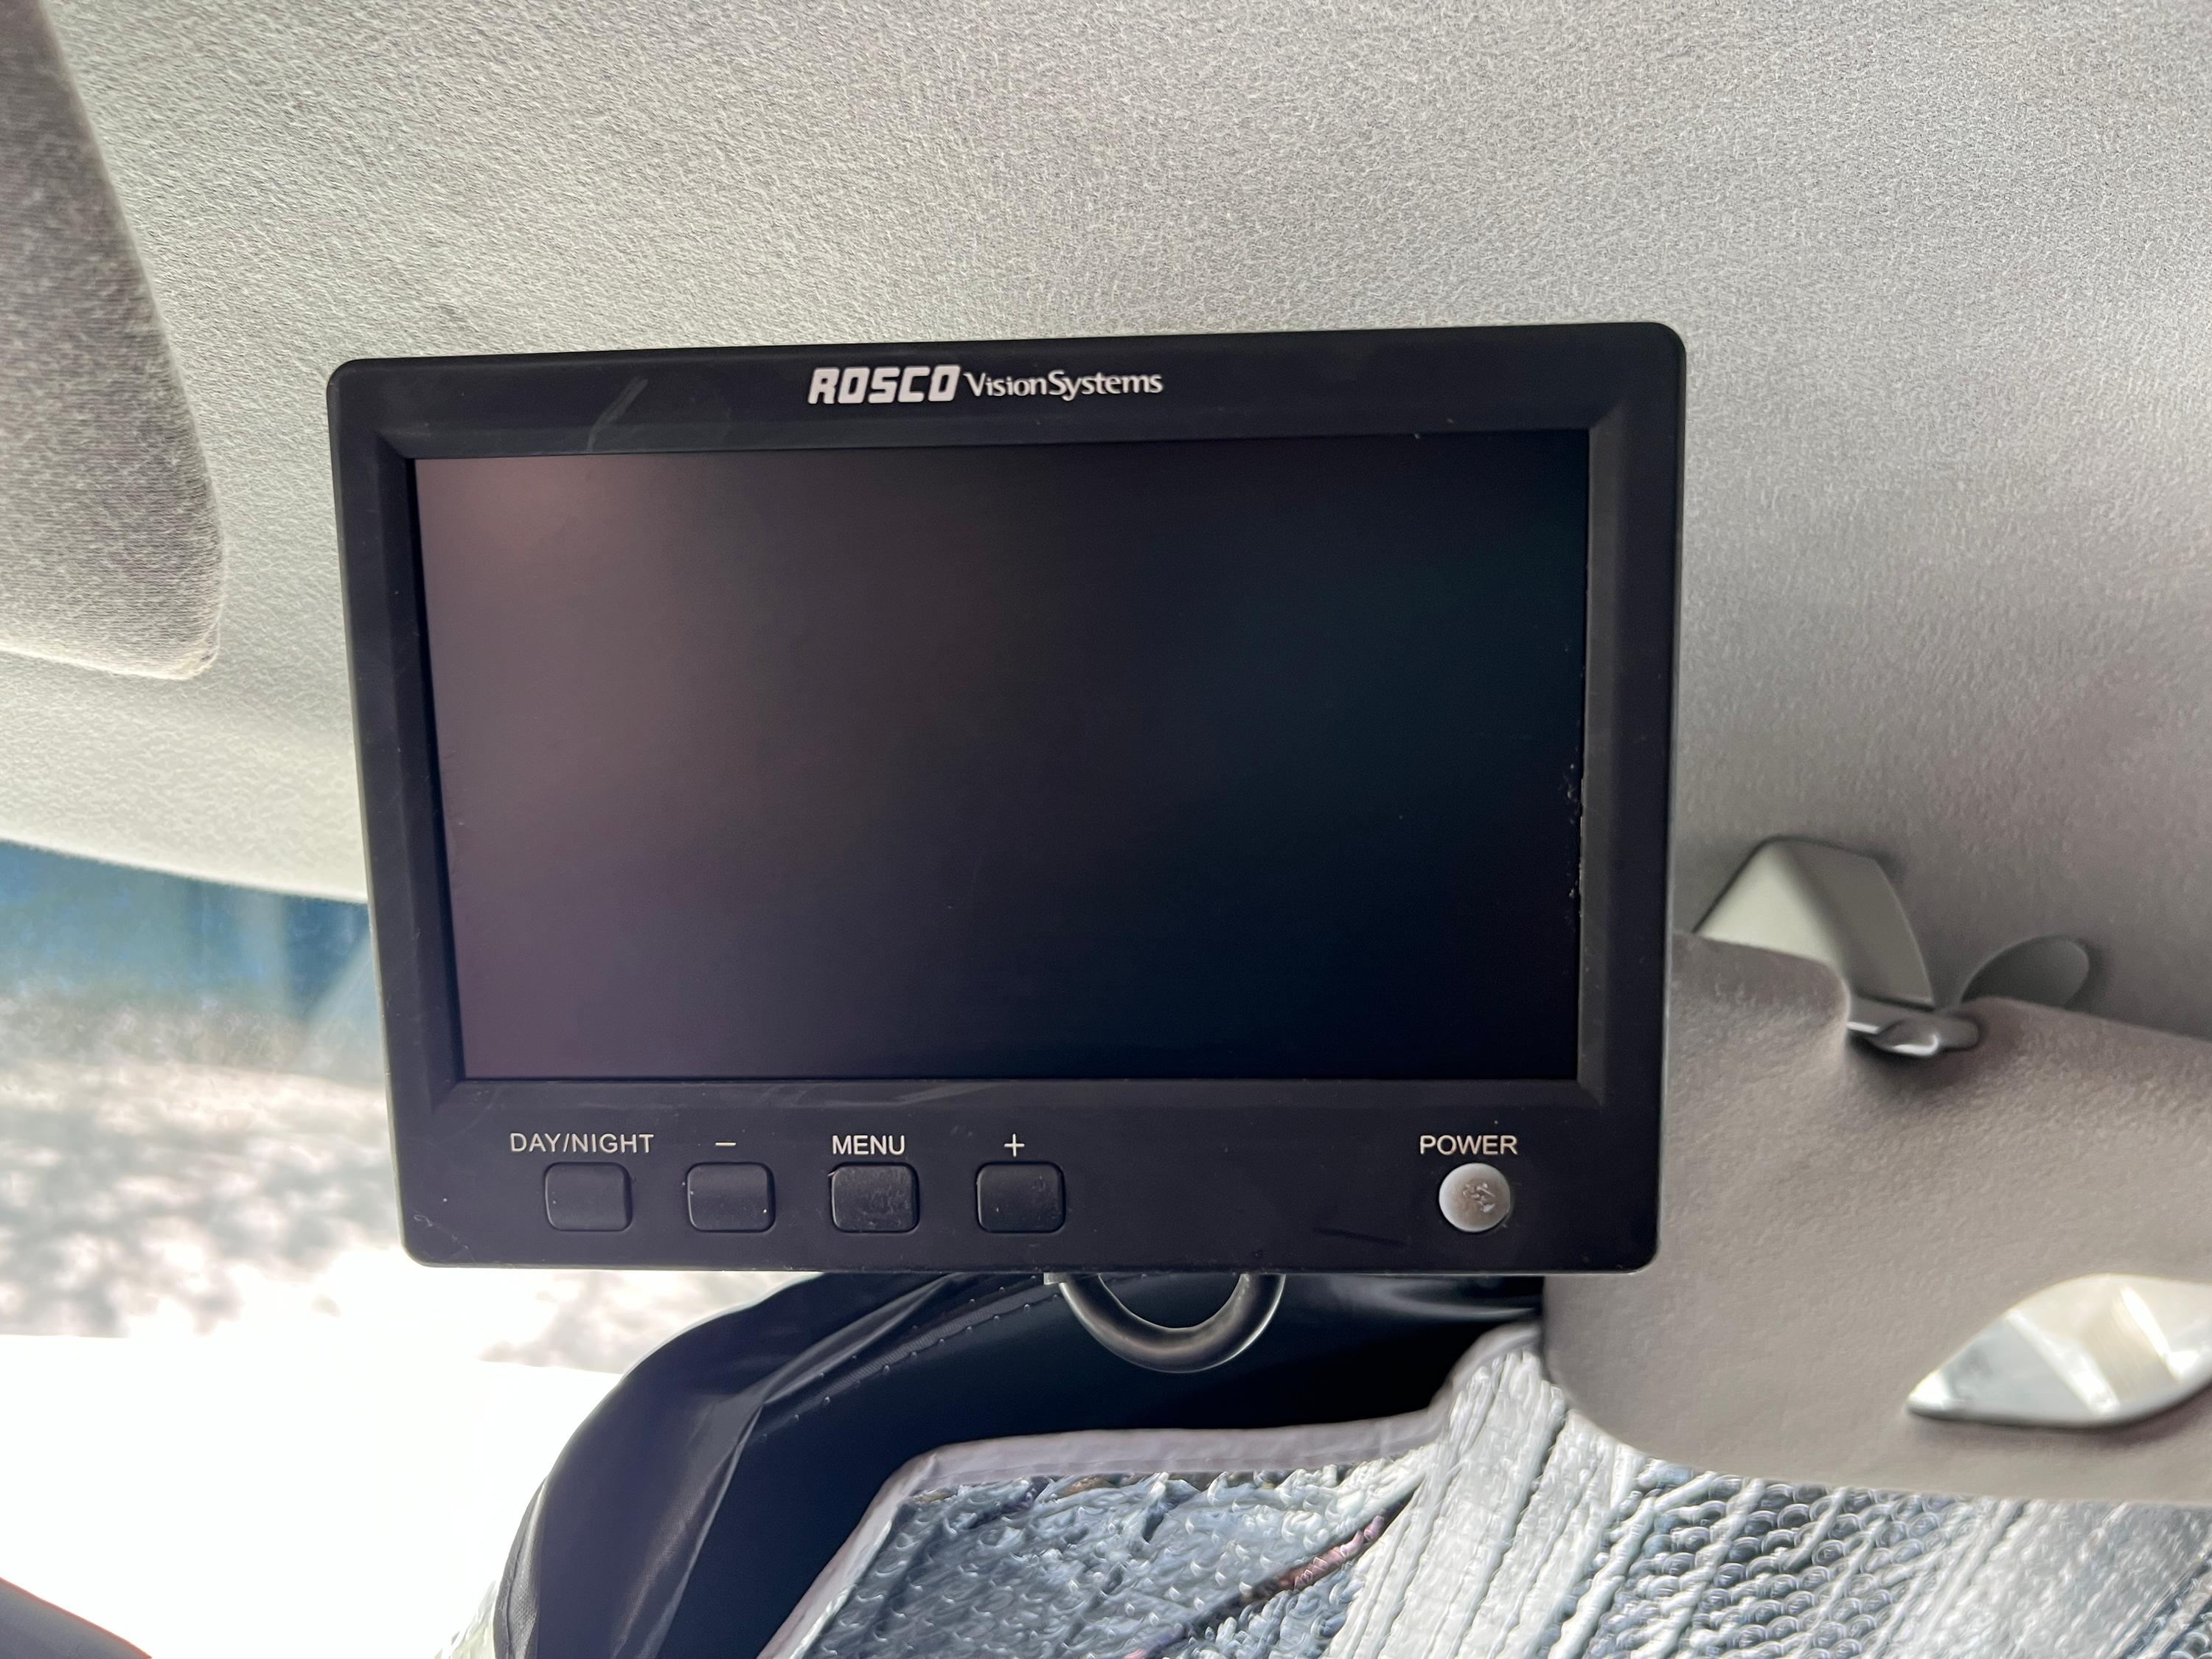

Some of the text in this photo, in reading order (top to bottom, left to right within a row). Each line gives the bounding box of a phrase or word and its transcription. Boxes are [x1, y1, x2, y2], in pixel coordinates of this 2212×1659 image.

[807, 364, 961, 404] ROSCO
[508, 1132, 655, 1154] DAY/NIGHT
[831, 1134, 906, 1155] MENU
[1419, 1134, 1518, 1155] POWER
